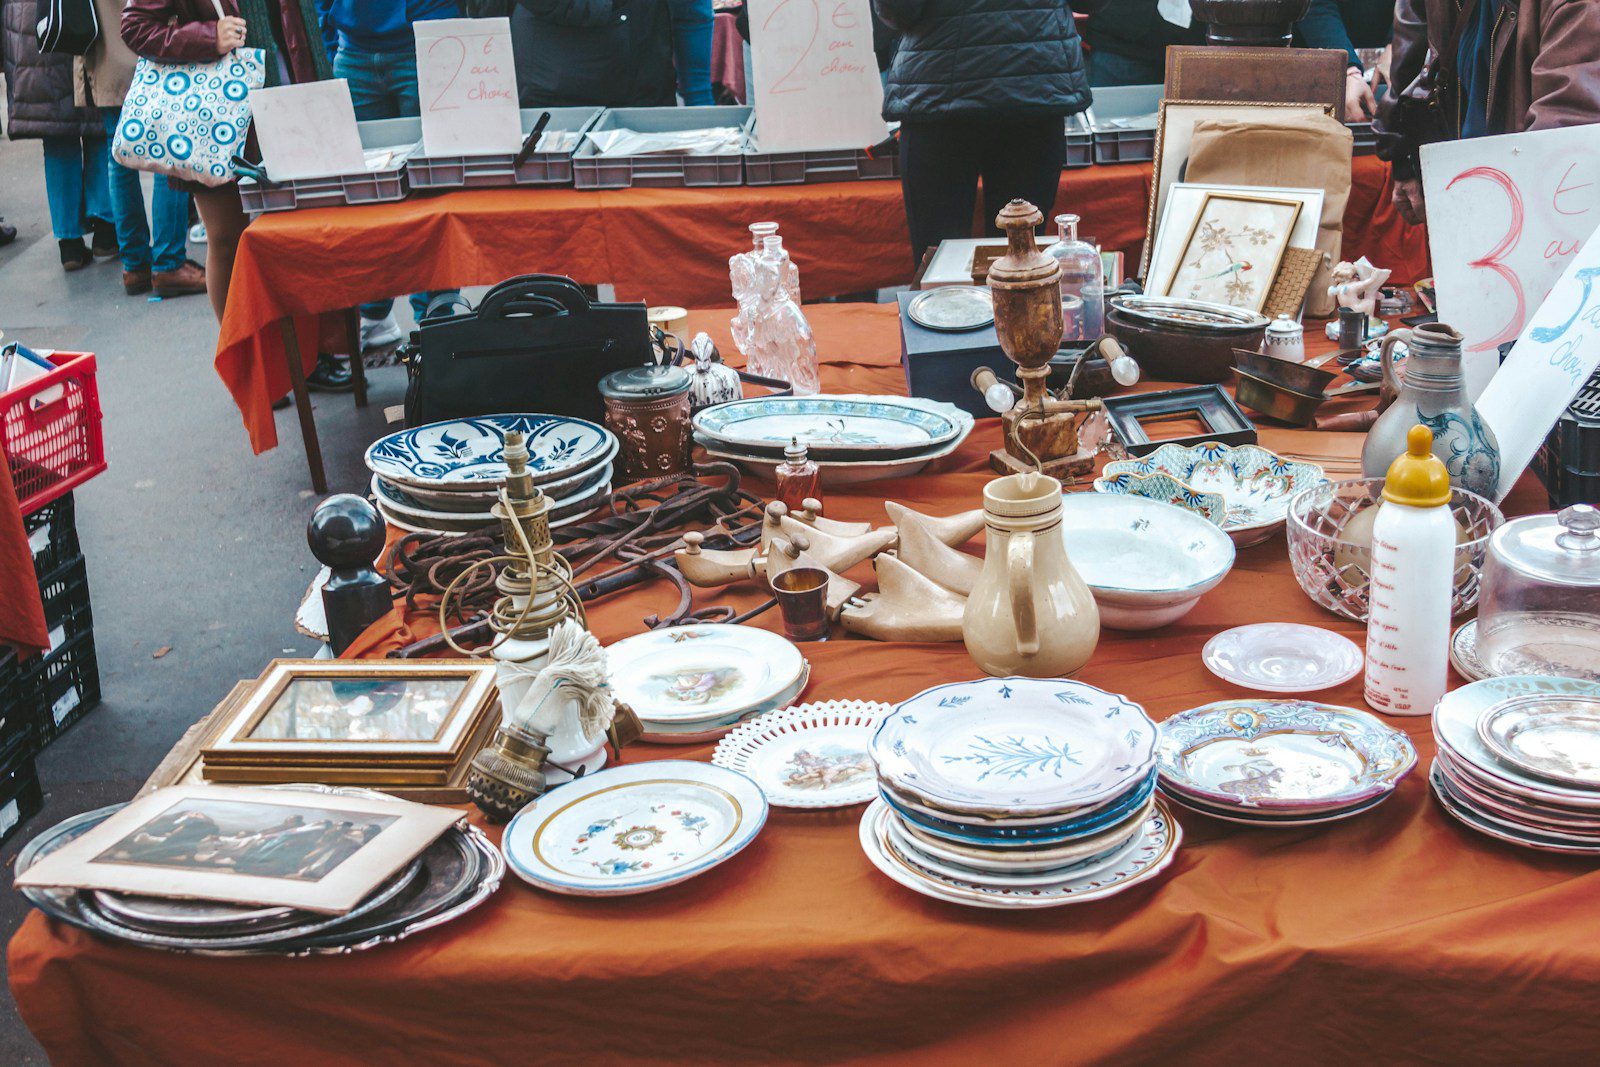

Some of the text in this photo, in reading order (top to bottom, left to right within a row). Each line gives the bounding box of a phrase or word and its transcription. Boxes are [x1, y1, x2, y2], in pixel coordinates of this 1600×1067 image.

[428, 35, 466, 112] 2
[762, 0, 820, 94] 2
[1445, 166, 1526, 353] 3
